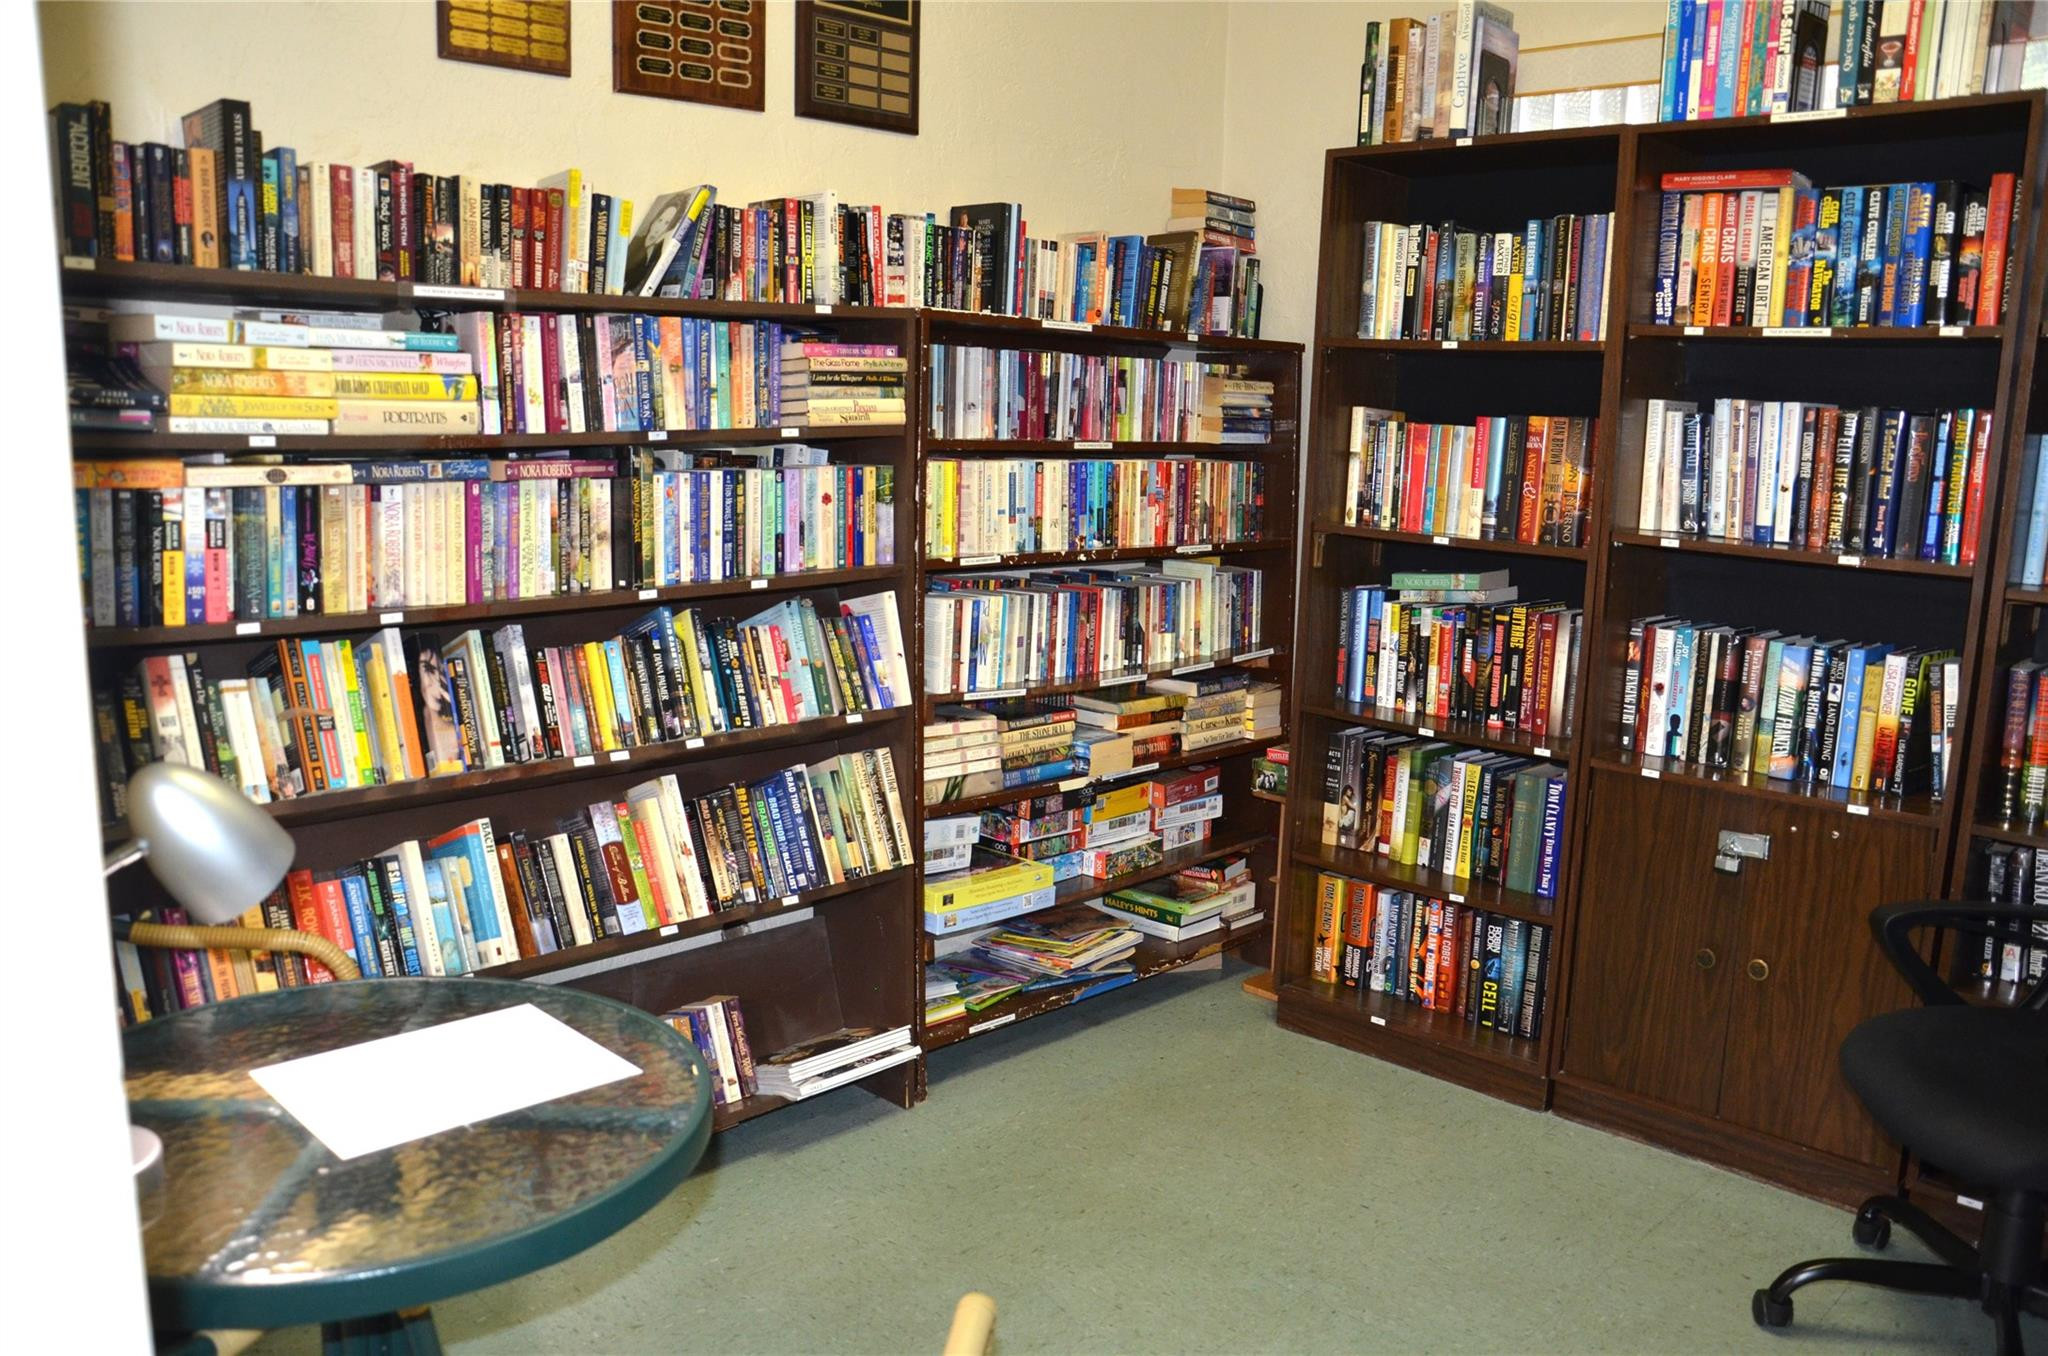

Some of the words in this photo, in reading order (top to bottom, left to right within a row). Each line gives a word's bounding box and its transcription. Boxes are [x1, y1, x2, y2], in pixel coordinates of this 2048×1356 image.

[1461, 4, 1471, 41] Atwood
[1453, 53, 1468, 108] Captive
[1777, 56, 1787, 89] Cookbook
[234, 113, 243, 144] STEVE
[69, 121, 92, 190] ACCIDENT
[235, 147, 245, 180] BERRY
[379, 196, 390, 221] Body
[1844, 191, 1856, 217] CLIVE
[1868, 191, 1881, 216] CLIVE
[400, 218, 408, 246] VICTIM
[598, 211, 607, 235] SANDRA
[1528, 223, 1538, 240] ALEX
[382, 224, 391, 250] Work
[595, 236, 605, 262] BROWN
[732, 223, 741, 258] TATTOOED
[1840, 219, 1853, 258] CUSSLER
[1865, 218, 1878, 261] CUSSLER
[1512, 237, 1521, 273] BAXTER
[1526, 241, 1536, 276] BERENSON
[1757, 225, 1774, 281] AMERICAN
[1151, 260, 1159, 285] MICHAEL
[1162, 259, 1172, 284] MICHAEL
[1810, 259, 1826, 310] NAVIGATOR
[1836, 260, 1847, 288] CHASE
[1148, 287, 1157, 316] CONNELLY
[1158, 285, 1168, 313] CONNELLY
[1755, 283, 1768, 308] DIRT
[813, 359, 824, 367] The
[825, 359, 841, 367] Glass
[841, 359, 860, 367] Flame
[202, 373, 232, 387] NORA
[233, 374, 276, 387] ROBERTS
[383, 411, 447, 423] PORTRAITS
[840, 413, 871, 424] Spindrift
[1553, 421, 1566, 436] DAN
[1573, 421, 1582, 437] DAN
[1844, 413, 1857, 435] DAVID
[1801, 431, 1813, 461] CROSSING
[1956, 419, 1969, 451] JANET
[1550, 439, 1563, 465] BROWN
[1568, 443, 1580, 483] BROWN
[1835, 438, 1852, 464] ELLIS
[372, 464, 393, 477] NORA
[393, 464, 425, 478] ROBERTS
[520, 465, 541, 478] NORA
[542, 463, 572, 476] ROBERTS
[1526, 452, 1536, 483] ANGELS
[1800, 462, 1811, 478] OVER
[1833, 468, 1849, 487] LIFE
[1948, 453, 1966, 514] EVANOVICH
[384, 501, 401, 526] NORA
[1522, 495, 1533, 528] DEMONS
[1562, 492, 1578, 543] INFERNO
[1798, 497, 1807, 529] EDWARD
[1829, 492, 1846, 540] SENTENCE
[152, 526, 162, 550] NORA
[384, 530, 401, 567] ROBERTS
[152, 552, 162, 585] ROBERTS
[1510, 607, 1526, 649] OUTRAGE
[290, 650, 301, 675] CIRCE
[653, 653, 664, 674] DIANA
[1681, 644, 1689, 660] JOY
[193, 669, 205, 689] Labor
[636, 660, 646, 682] DIANA
[1810, 648, 1826, 687] NATURAL
[1835, 660, 1846, 680] NICCI
[1887, 664, 1898, 680] LISA
[195, 690, 206, 704] Day
[640, 683, 651, 709] PALMER
[657, 675, 669, 701] PALMER
[1671, 670, 1680, 708] HOUSEKEEPER
[1776, 670, 1799, 717] JONATHAN
[1882, 682, 1896, 715] GARDNER
[458, 688, 470, 723] MIMOSA
[466, 725, 477, 754] GROVE
[1200, 720, 1217, 730] Curse
[1224, 715, 1242, 725] Kings
[1804, 690, 1820, 729] SELECTION
[1825, 702, 1837, 726] LAND
[1771, 718, 1793, 757] FRANZEN
[1820, 732, 1834, 761] LIVING
[880, 751, 895, 777] Victoria
[785, 771, 797, 792] BRAD
[886, 778, 897, 793] Holt
[1466, 780, 1476, 793] LEE
[1546, 783, 1563, 802] TOM
[2025, 767, 2046, 806] MOTIVE
[768, 797, 781, 818] BRAD
[790, 794, 802, 814] THOR
[1464, 794, 1475, 815] CHILD
[757, 800, 769, 827] BRAD
[763, 829, 776, 855] THOR
[774, 820, 786, 841] THOR
[799, 826, 807, 838] CODE
[1544, 804, 1561, 838] CLANCY
[481, 822, 495, 853] BACH
[1545, 839, 1556, 854] EVERY
[522, 858, 535, 880] Daniel
[782, 852, 793, 874] BLACK
[802, 848, 815, 870] CONDUCT
[1544, 855, 1553, 868] MAN
[387, 871, 408, 915] SANDFORD
[527, 880, 537, 897] Silva
[728, 871, 736, 894] TAYLOR
[732, 873, 740, 890] BRAD
[786, 875, 797, 889] LIST
[1541, 873, 1551, 887] TIGER
[346, 882, 360, 914] JENNIFER
[1105, 897, 1134, 912] HALEY'S
[1135, 905, 1159, 918] HINTS
[351, 915, 365, 934] RYAN
[1443, 906, 1454, 938] HARLAN
[399, 926, 414, 946] HOLY
[403, 949, 420, 976] GHOST
[1441, 940, 1452, 966] COBEN
[1481, 982, 1498, 1012] CELL
